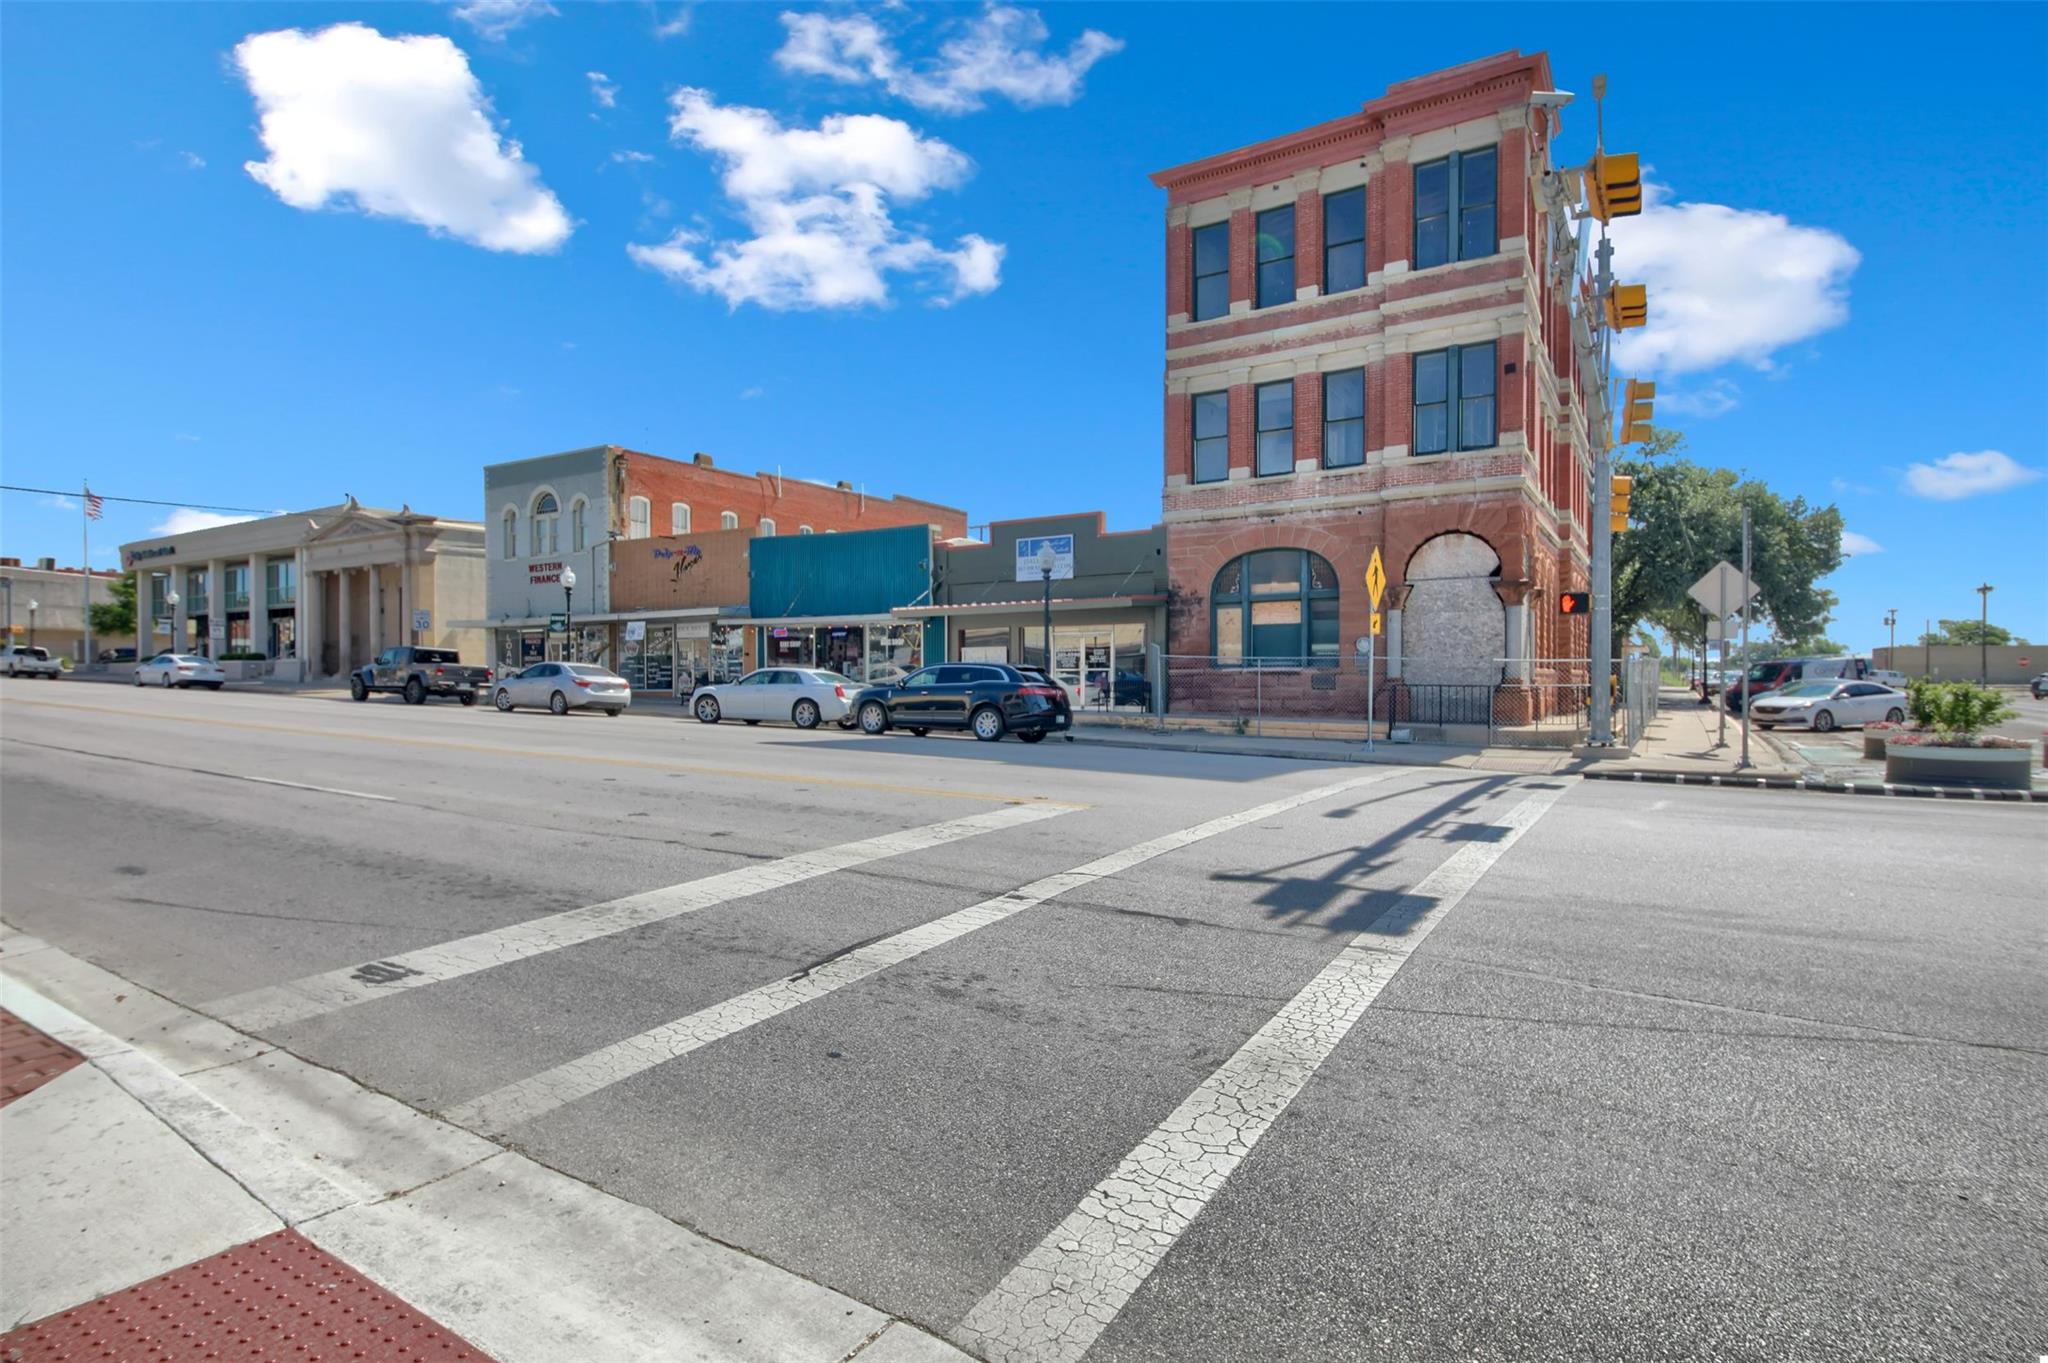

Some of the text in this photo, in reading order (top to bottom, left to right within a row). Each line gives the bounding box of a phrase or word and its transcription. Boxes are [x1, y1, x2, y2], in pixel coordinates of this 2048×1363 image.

[528, 562, 562, 573] WESTERN
[530, 573, 560, 584] FINANCE
[415, 620, 429, 629] 30
